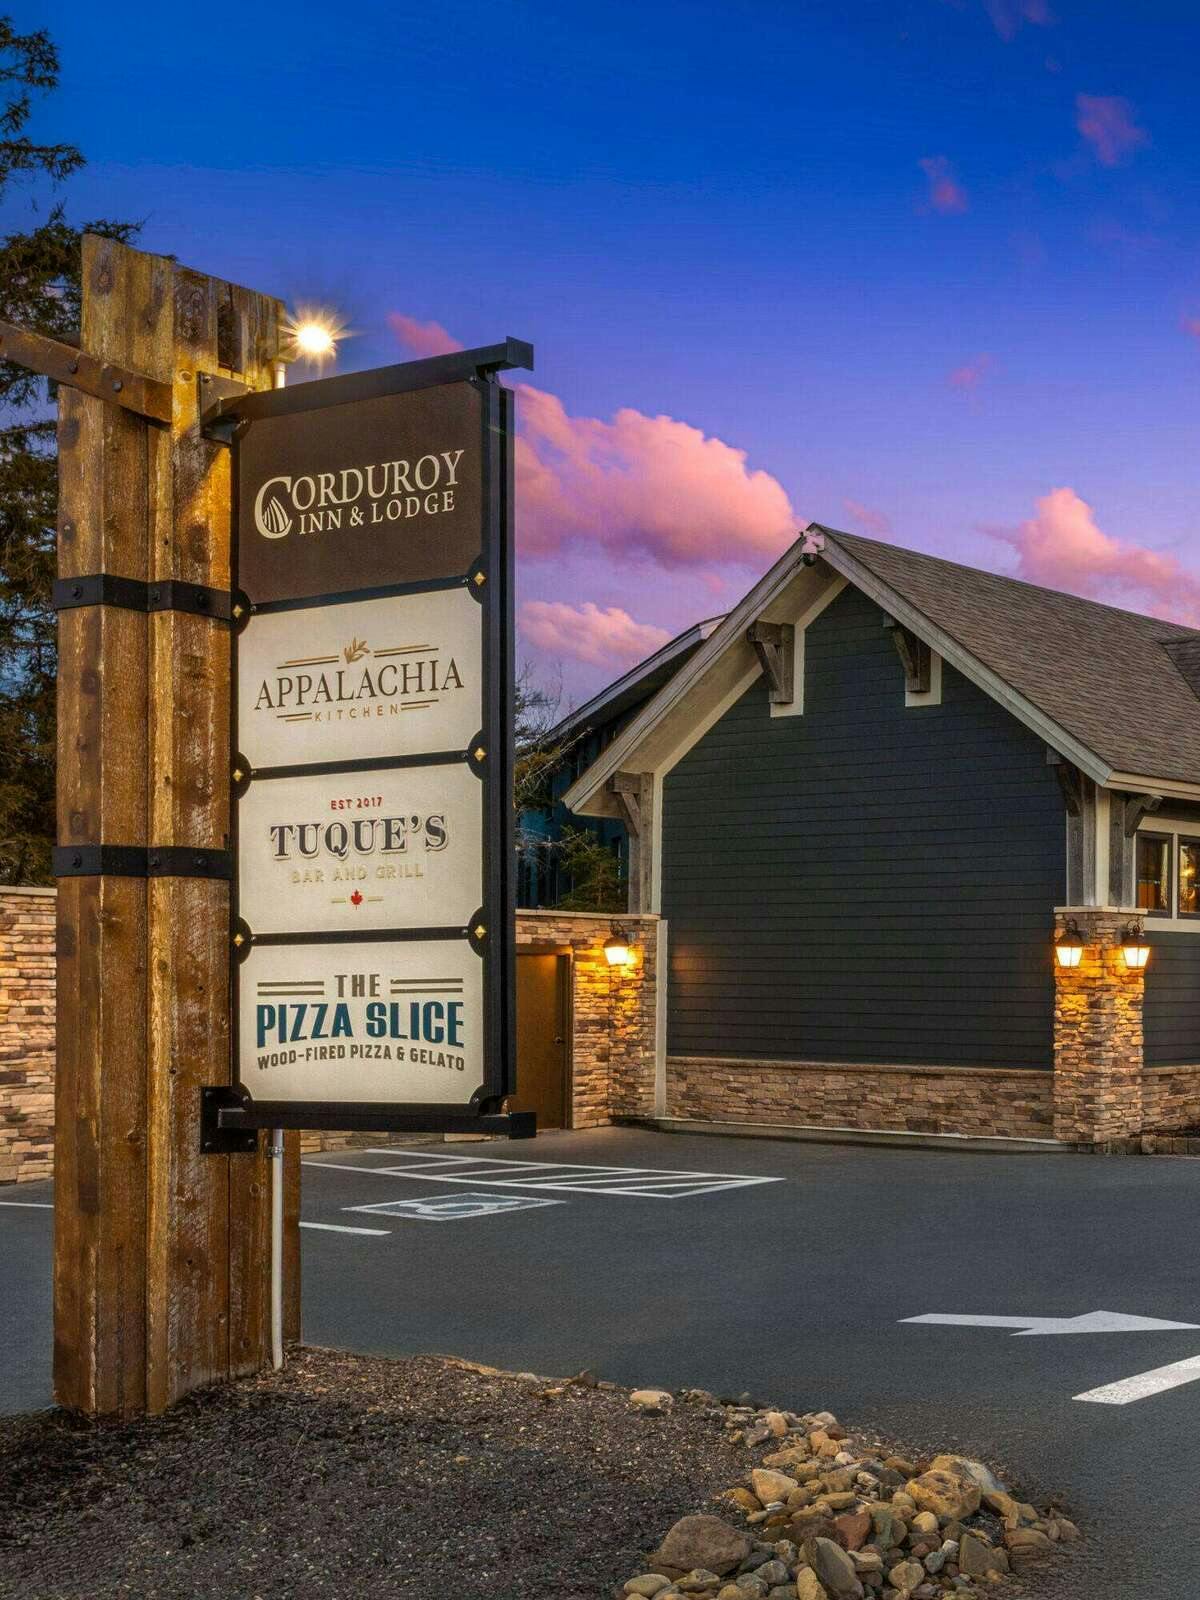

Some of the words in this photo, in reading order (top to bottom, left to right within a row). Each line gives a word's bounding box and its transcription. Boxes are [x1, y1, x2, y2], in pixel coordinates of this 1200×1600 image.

[254, 450, 465, 539] CORDUROY
[299, 508, 342, 536] INN
[350, 505, 364, 527] &
[371, 491, 456, 522] LODGE
[254, 658, 465, 711] APPALACHIA
[314, 703, 399, 722] KITCHEN
[331, 799, 353, 810] EST
[356, 797, 383, 809] 2017
[270, 815, 450, 861] TUQUE'S
[290, 869, 324, 884] BAR
[333, 866, 367, 881] AND
[375, 863, 424, 880] GRILL
[334, 974, 381, 998] THE
[256, 1003, 354, 1049] PIZZA
[366, 1001, 464, 1049] SLICE
[257, 1044, 346, 1070] WOOD-FIRED
[350, 1045, 391, 1060] PIZZA
[396, 1046, 405, 1061] &
[410, 1047, 465, 1071] GELATO
